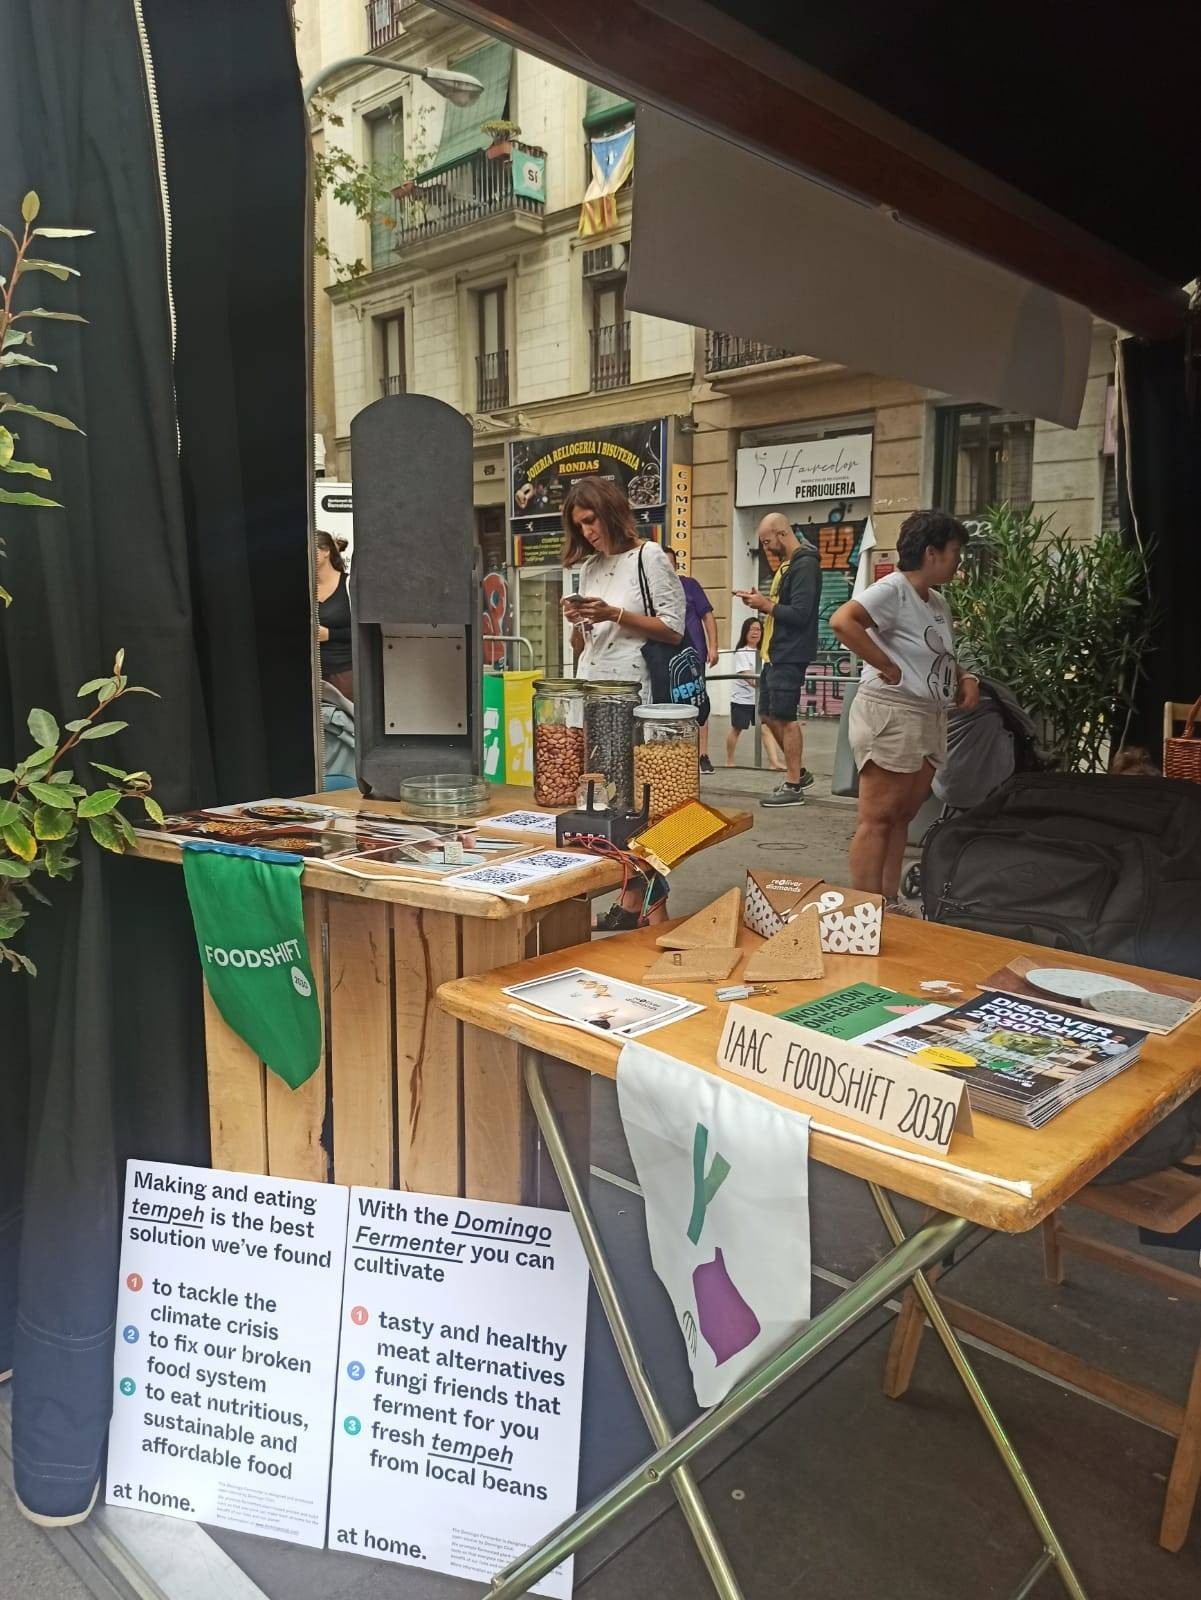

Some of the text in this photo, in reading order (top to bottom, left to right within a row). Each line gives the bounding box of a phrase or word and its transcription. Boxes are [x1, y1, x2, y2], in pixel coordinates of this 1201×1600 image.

[552, 441, 596, 464] RELLOGERIA
[601, 442, 640, 471] BISUTERIA
[558, 460, 600, 474] RONDAS
[675, 471, 689, 539] COMPRO
[795, 481, 856, 499] PERRUQUERIA
[204, 939, 302, 968] FOODSHIFT
[782, 989, 867, 1022] NNOVATION
[803, 992, 893, 1029] ONFERENCE
[979, 1003, 1120, 1046] FOODSHIFT
[990, 997, 1114, 1038] DISCOVER
[724, 1020, 773, 1074] IAAC
[897, 1087, 957, 1146] 2030
[133, 1170, 318, 1216] Making and eating
[131, 1197, 315, 1239] tempeh is the best
[358, 1197, 553, 1245] With the Domingo
[129, 1225, 332, 1269] solution we’ve found
[354, 1225, 555, 1271] Fermenter you can
[353, 1255, 445, 1283] cultivate
[151, 1277, 172, 1297] to
[177, 1281, 239, 1307] tackle
[244, 1292, 277, 1313] the
[150, 1304, 279, 1341] climate crisis
[378, 1311, 434, 1340] tasty
[440, 1324, 480, 1344] and
[486, 1326, 568, 1362] healthy
[148, 1330, 169, 1349] to
[174, 1333, 199, 1354] fix
[203, 1341, 237, 1360] our
[242, 1344, 312, 1374] broken
[376, 1341, 566, 1388] meat alternatives
[146, 1355, 267, 1393] food system
[374, 1365, 428, 1395] fungi
[433, 1375, 508, 1406] friends
[514, 1390, 561, 1416] that
[144, 1382, 166, 1401] to
[170, 1390, 202, 1409] eat
[207, 1396, 309, 1432] nutritious,
[372, 1393, 540, 1441] ferment for you
[143, 1411, 298, 1454] sustainable and
[370, 1420, 425, 1448] fresh
[430, 1432, 515, 1465] tempeh
[141, 1436, 293, 1480] affordable food
[369, 1448, 549, 1501] from local beans
[112, 1482, 133, 1500] at
[137, 1484, 196, 1513] home.
[336, 1527, 358, 1546] at
[363, 1528, 427, 1560] home.
